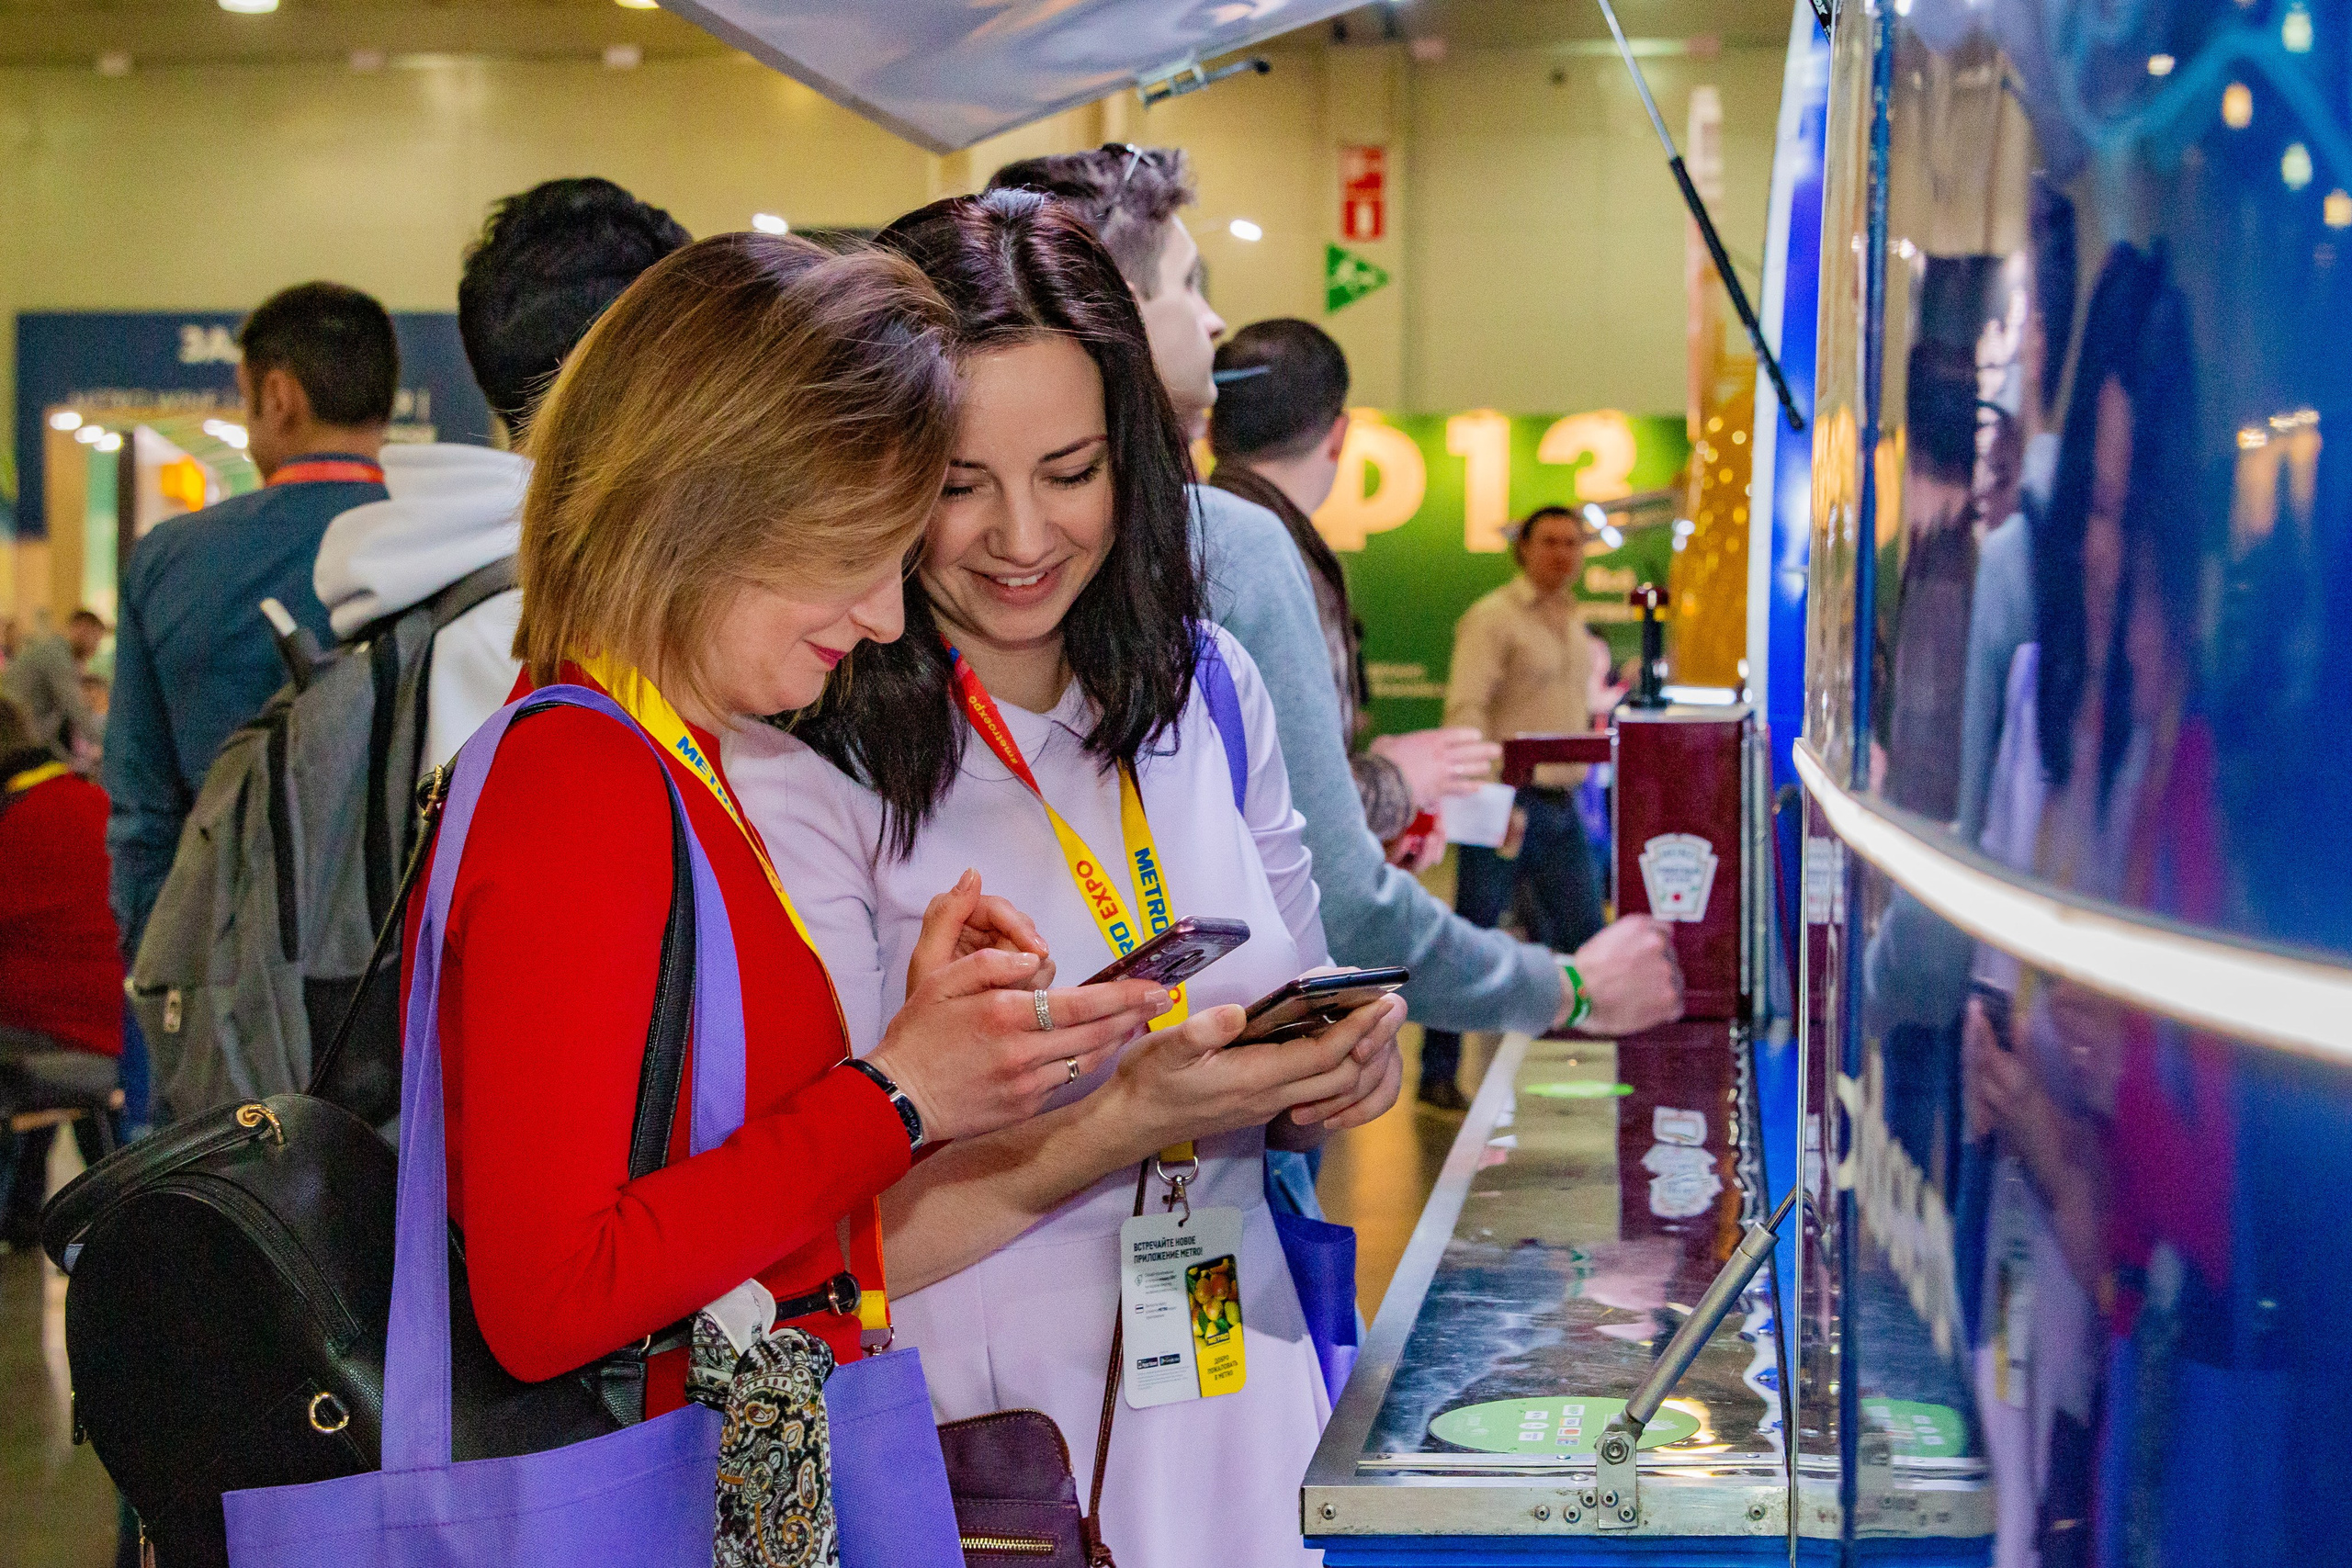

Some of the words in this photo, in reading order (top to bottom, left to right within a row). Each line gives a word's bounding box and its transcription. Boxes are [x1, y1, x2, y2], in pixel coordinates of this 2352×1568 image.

[1076, 860, 1119, 920] EXPO
[1134, 847, 1170, 935] METRO
[1134, 1236, 1174, 1252] ВСТРЕЧАЙТЕ
[1175, 1235, 1196, 1247] НОВОЕ
[1134, 1250, 1180, 1264] ПРИЛОЖЕНИЕ
[1181, 1247, 1204, 1258] METRO!
